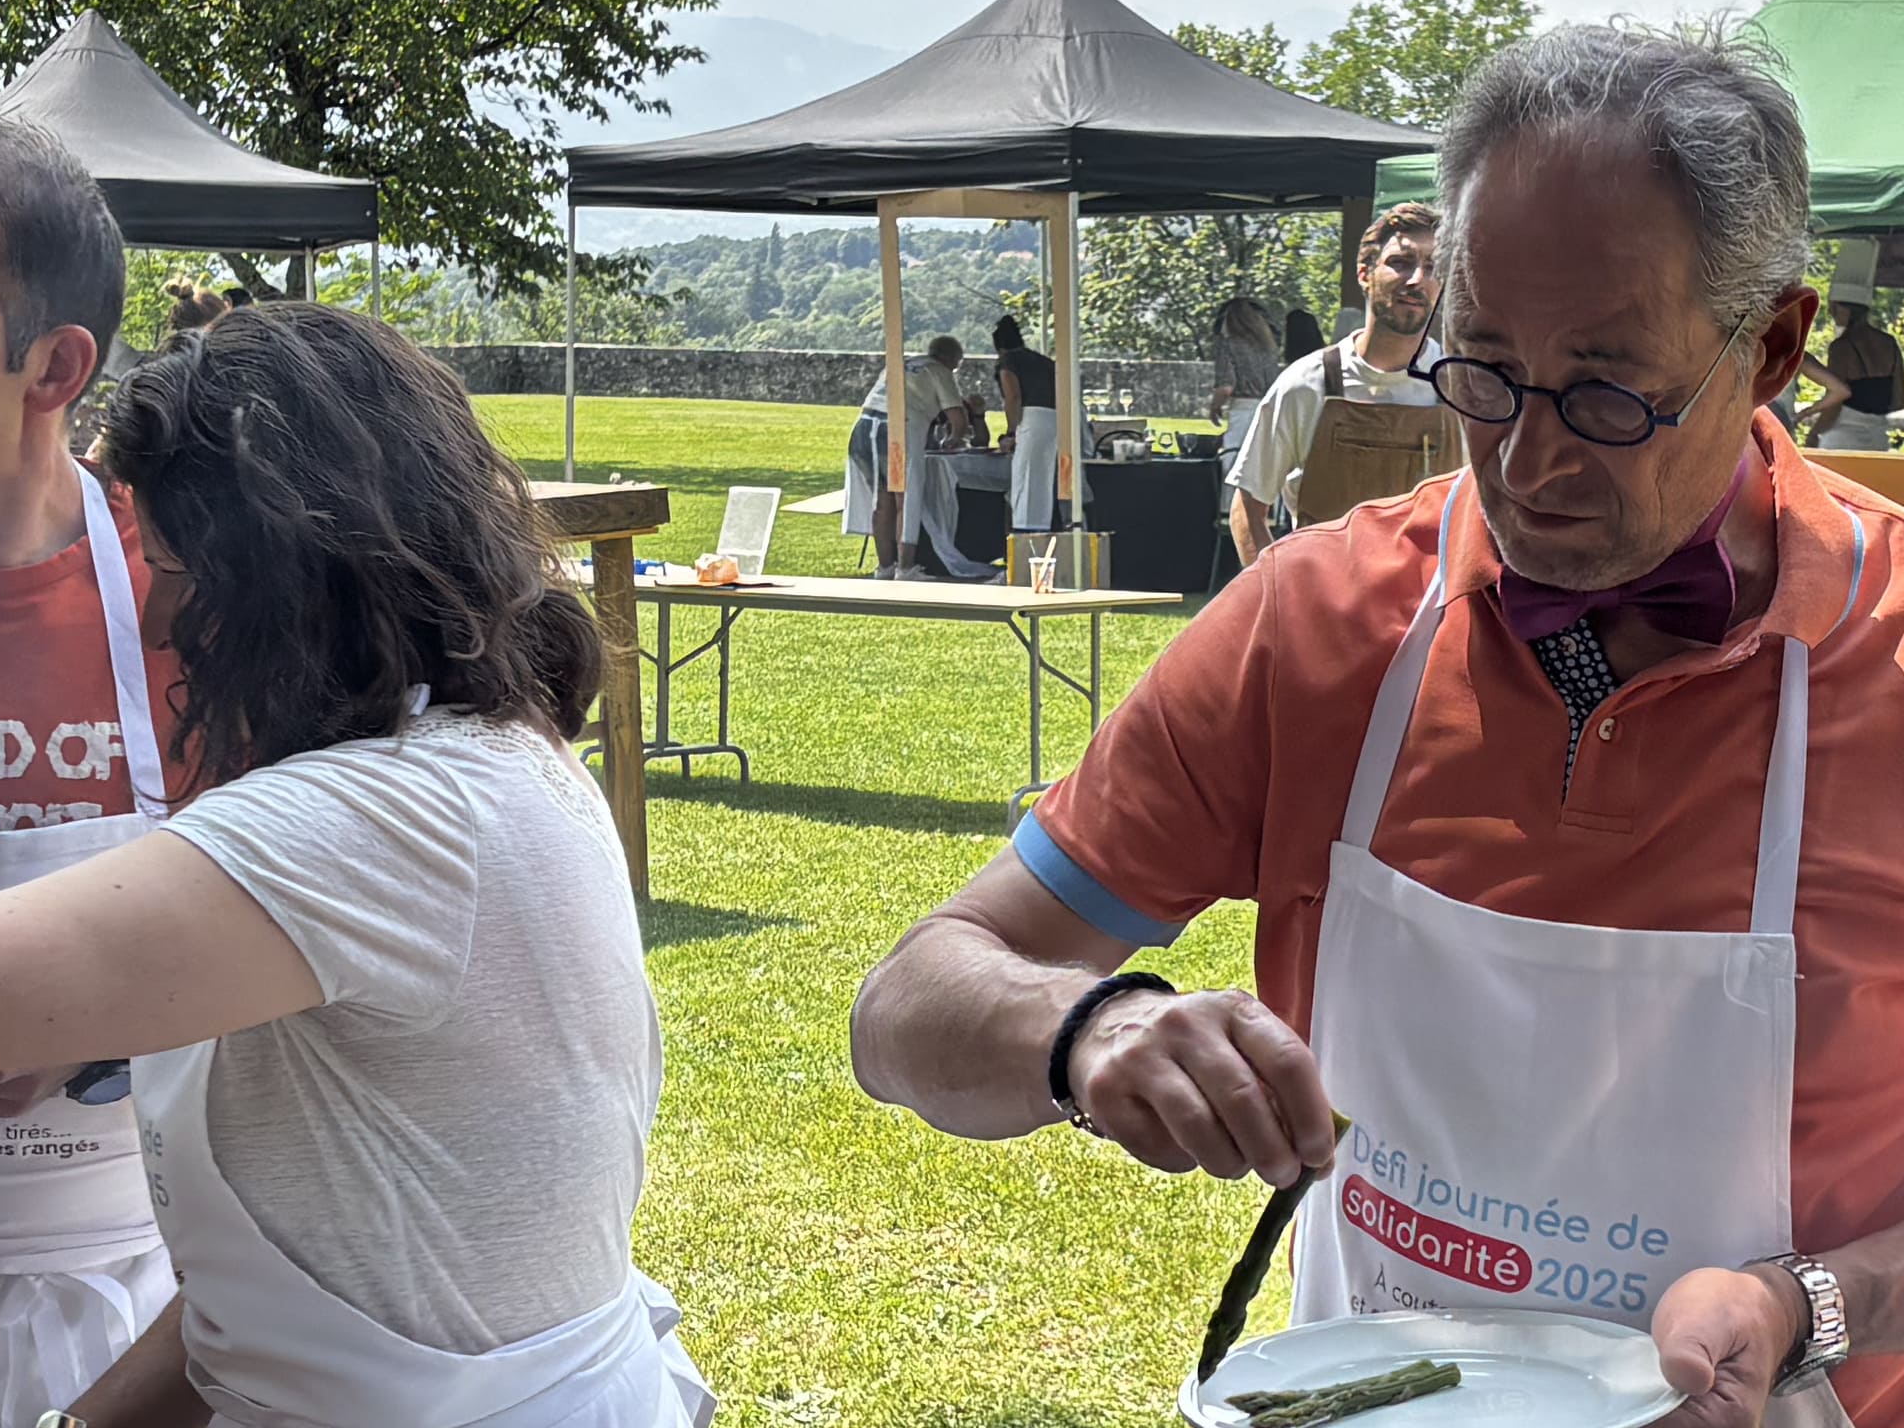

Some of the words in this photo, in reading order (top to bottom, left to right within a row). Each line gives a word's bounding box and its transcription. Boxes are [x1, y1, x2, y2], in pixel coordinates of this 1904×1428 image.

[46, 721, 125, 781] OF
[22, 1138, 101, 1159] rangés
[1353, 1123, 1407, 1189] Défi
[1413, 1163, 1590, 1243] journée
[1606, 1213, 1669, 1256] de
[1346, 1187, 1520, 1286] solidarité
[1534, 1257, 1649, 1313] 2025
